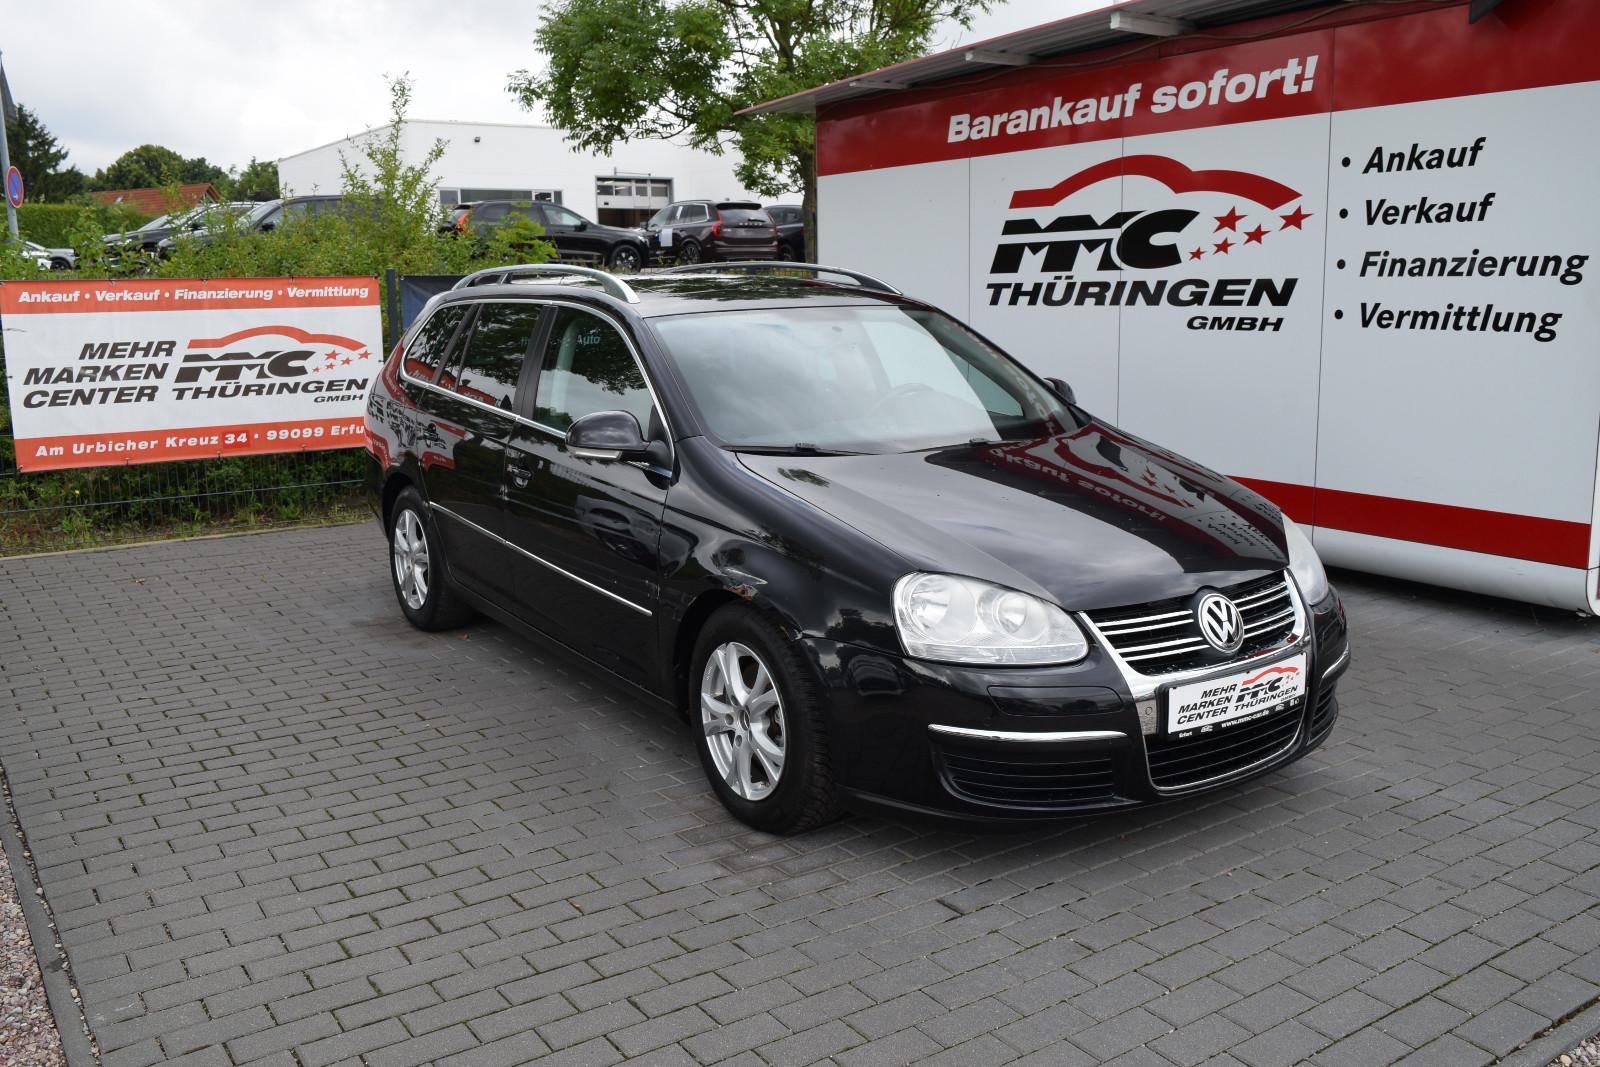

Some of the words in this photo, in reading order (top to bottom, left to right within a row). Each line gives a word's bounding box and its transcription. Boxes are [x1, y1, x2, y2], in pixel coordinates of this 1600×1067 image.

[947, 83, 1143, 144] Barankauf
[1150, 54, 1320, 114] sofort!
[1362, 136, 1487, 174] Ankauf
[1365, 192, 1496, 226] Verkauf
[989, 208, 1201, 274] MMC
[1359, 248, 1589, 286] Finanzierung
[18, 290, 81, 303] Ankauf
[95, 289, 161, 302] Verkauf
[174, 287, 274, 301] Finanzierung
[287, 285, 369, 299] Vermittlung
[985, 275, 1300, 308] THÜRINGEN
[1186, 315, 1285, 332] GMBH
[1360, 302, 1563, 343] Vermittlung
[79, 340, 177, 361] MEHR
[23, 363, 169, 386] MARKEN
[174, 350, 317, 383] MMC
[23, 385, 160, 409] CENTER
[172, 378, 369, 401] THÜRINGEN
[313, 393, 364, 403] GMBH
[35, 445, 64, 457] Am
[72, 439, 158, 455] Urbicher
[165, 435, 219, 448] Kreuz
[224, 432, 248, 445] 34
[266, 426, 324, 441] 99099
[330, 424, 365, 436] Erfu
[1200, 683, 1238, 699] MEHR
[1234, 685, 1298, 712] THÜRINGEN
[1177, 706, 1229, 725] CENTER
[1178, 695, 1233, 715] MARKEN
